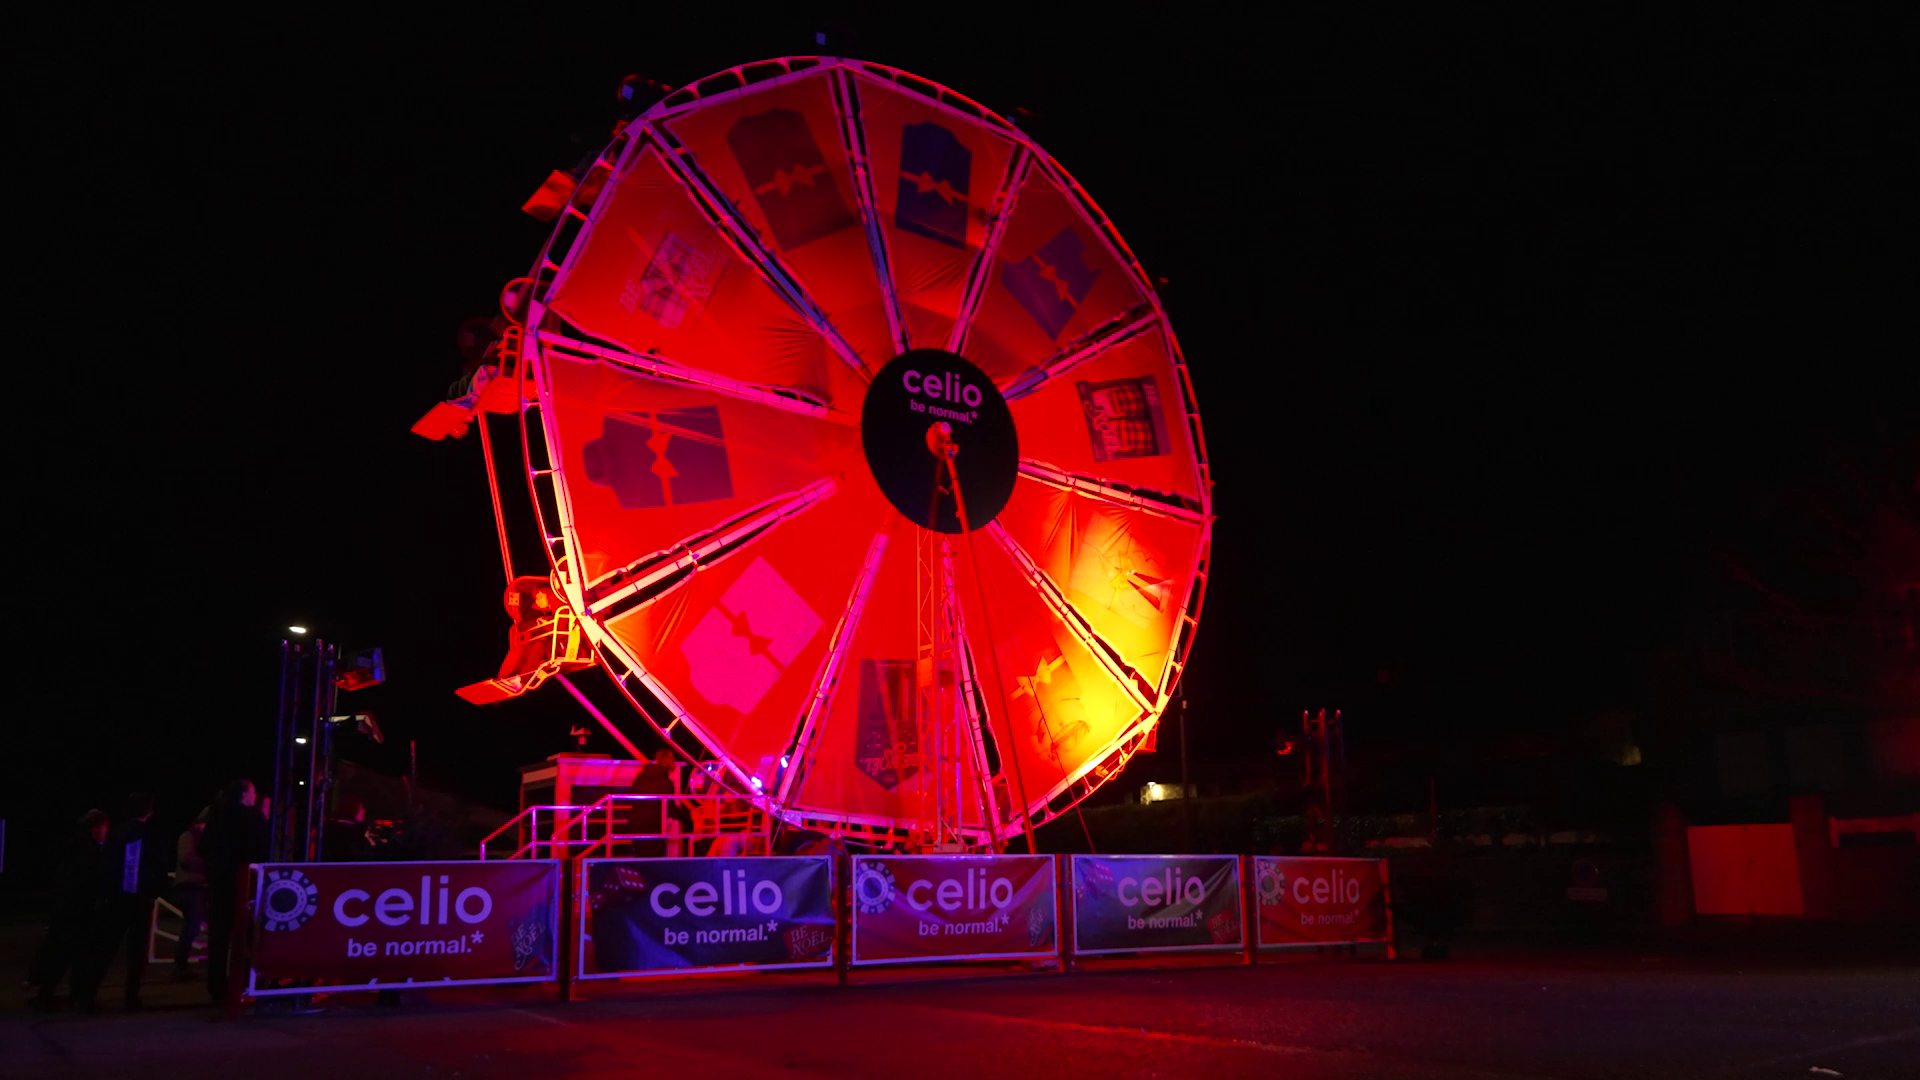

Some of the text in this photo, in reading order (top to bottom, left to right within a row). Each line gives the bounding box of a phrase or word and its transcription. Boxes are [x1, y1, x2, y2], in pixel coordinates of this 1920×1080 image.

[902, 369, 983, 408] celio
[910, 399, 926, 412] be
[649, 869, 783, 918] celio
[907, 867, 1014, 912] celio
[1117, 867, 1206, 907] celio
[1291, 868, 1360, 905] celio
[333, 874, 493, 928] celio
[918, 918, 940, 936] be
[1127, 913, 1146, 930] be
[1300, 911, 1315, 925] be
[663, 925, 689, 946] be
[790, 925, 809, 943] BE
[347, 938, 378, 958] be
